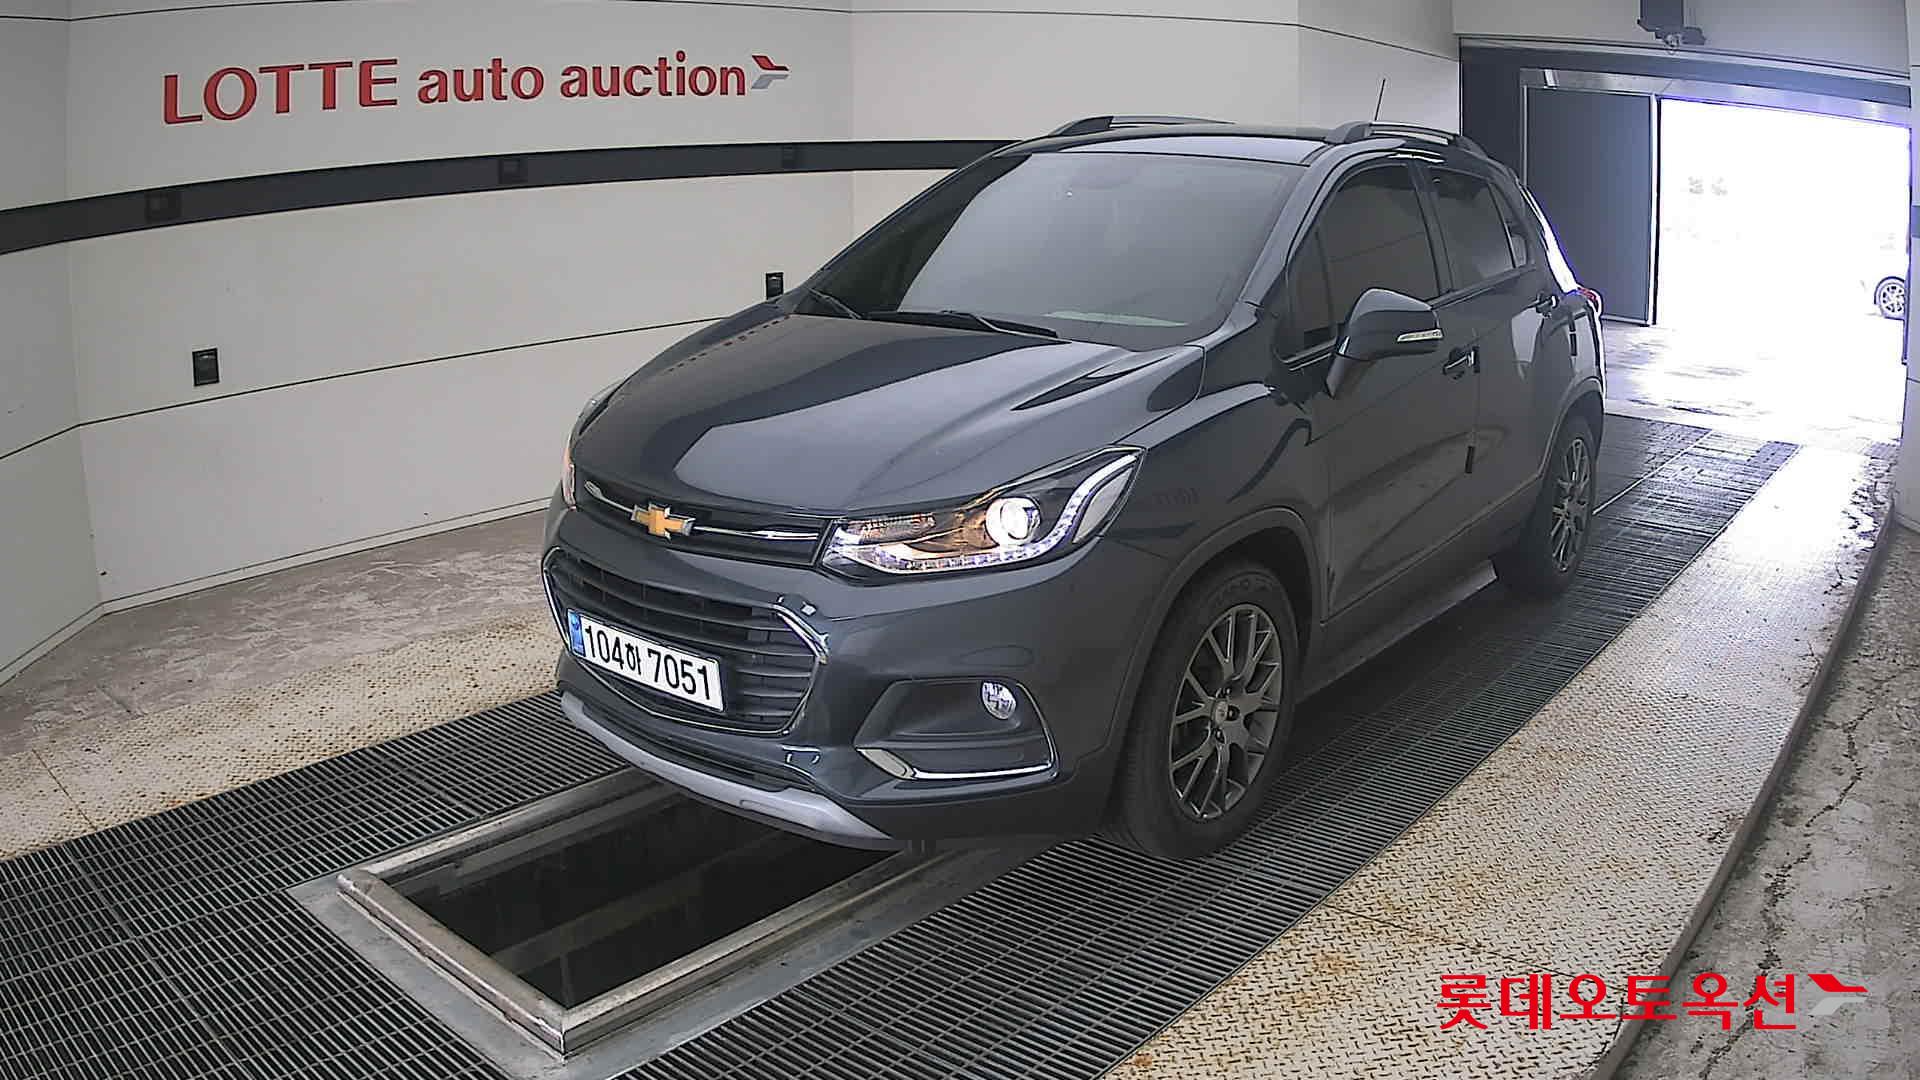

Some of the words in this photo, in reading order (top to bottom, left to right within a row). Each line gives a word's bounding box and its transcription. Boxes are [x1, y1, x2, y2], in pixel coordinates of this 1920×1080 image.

[164, 58, 398, 124] LOTTE
[418, 58, 544, 103] auto
[560, 50, 746, 98] auction
[585, 625, 643, 676] 104하
[648, 648, 711, 701] 7051
